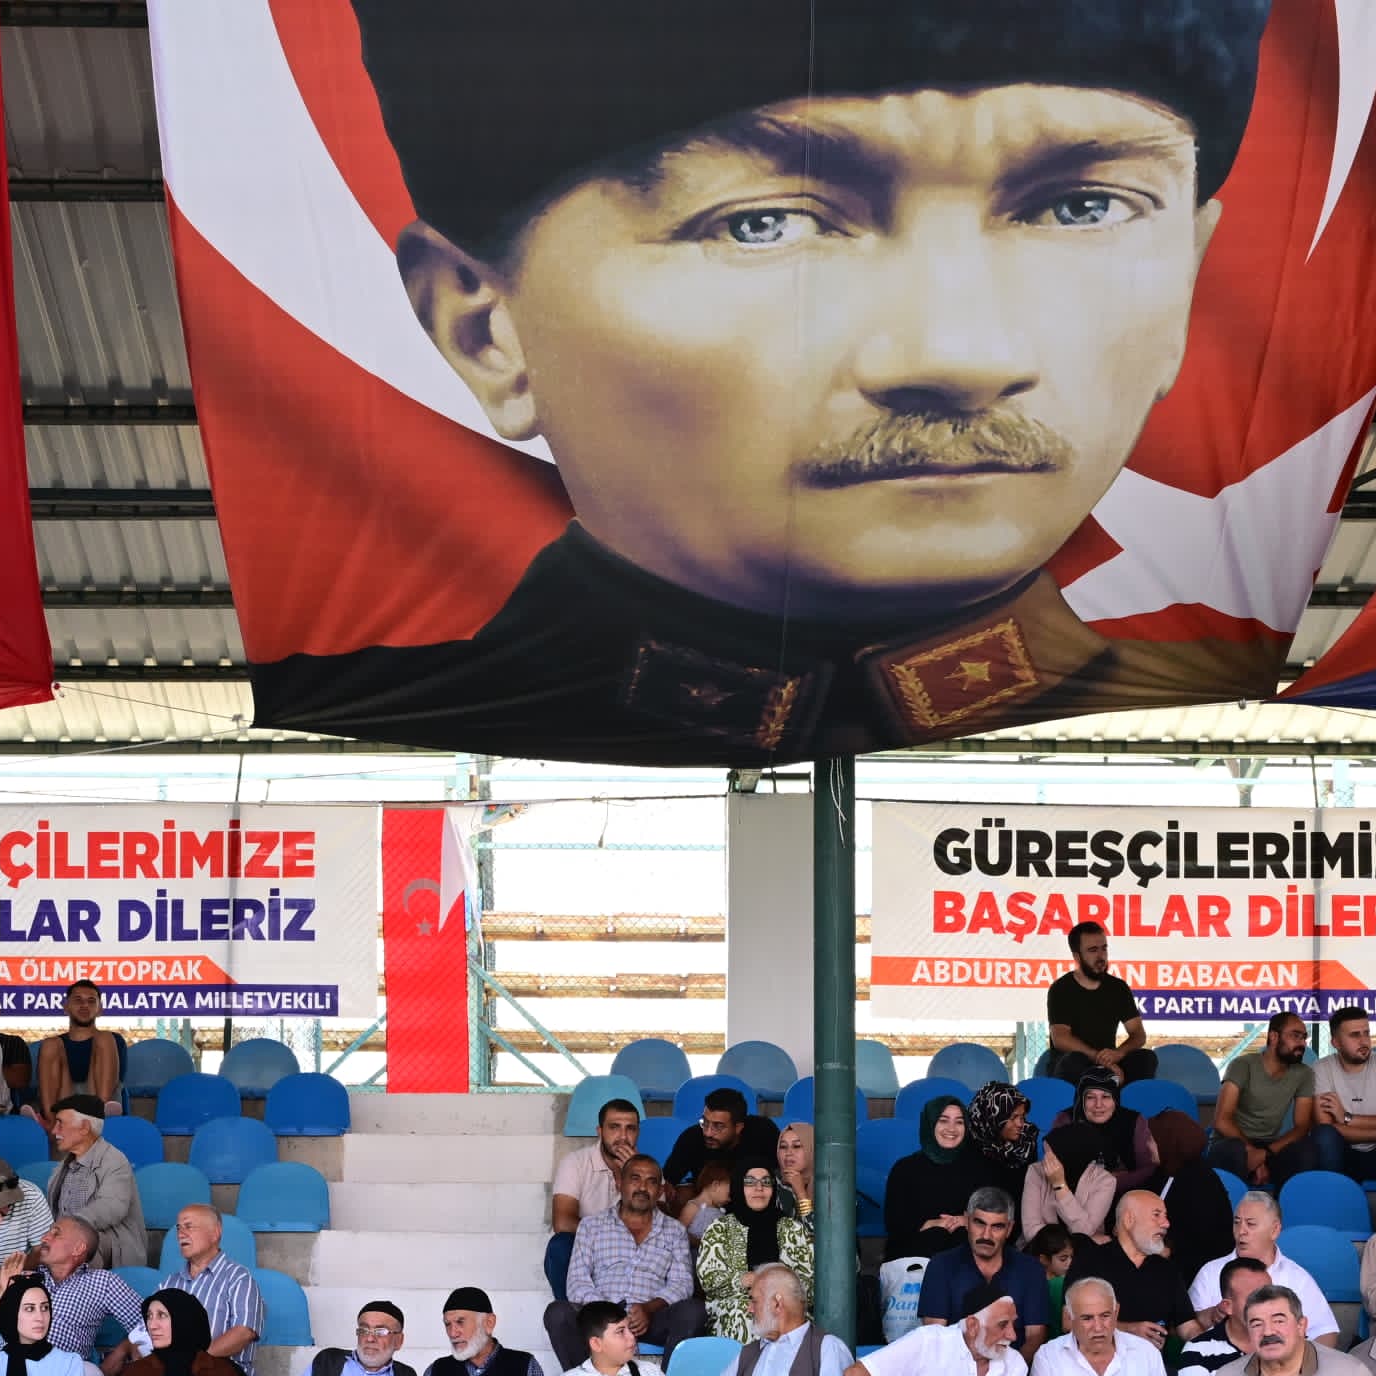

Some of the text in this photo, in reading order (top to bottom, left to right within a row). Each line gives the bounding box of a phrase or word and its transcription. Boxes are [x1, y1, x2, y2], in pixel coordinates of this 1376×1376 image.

[118, 888, 316, 942] DİLERİZ
[933, 890, 1232, 944] BAŞARILAR
[20, 957, 202, 982] ÖLMEZTOPRAK
[911, 960, 1298, 988] ABDURRAHAN BABACAN
[1220, 996, 1320, 1015] MALATYA
